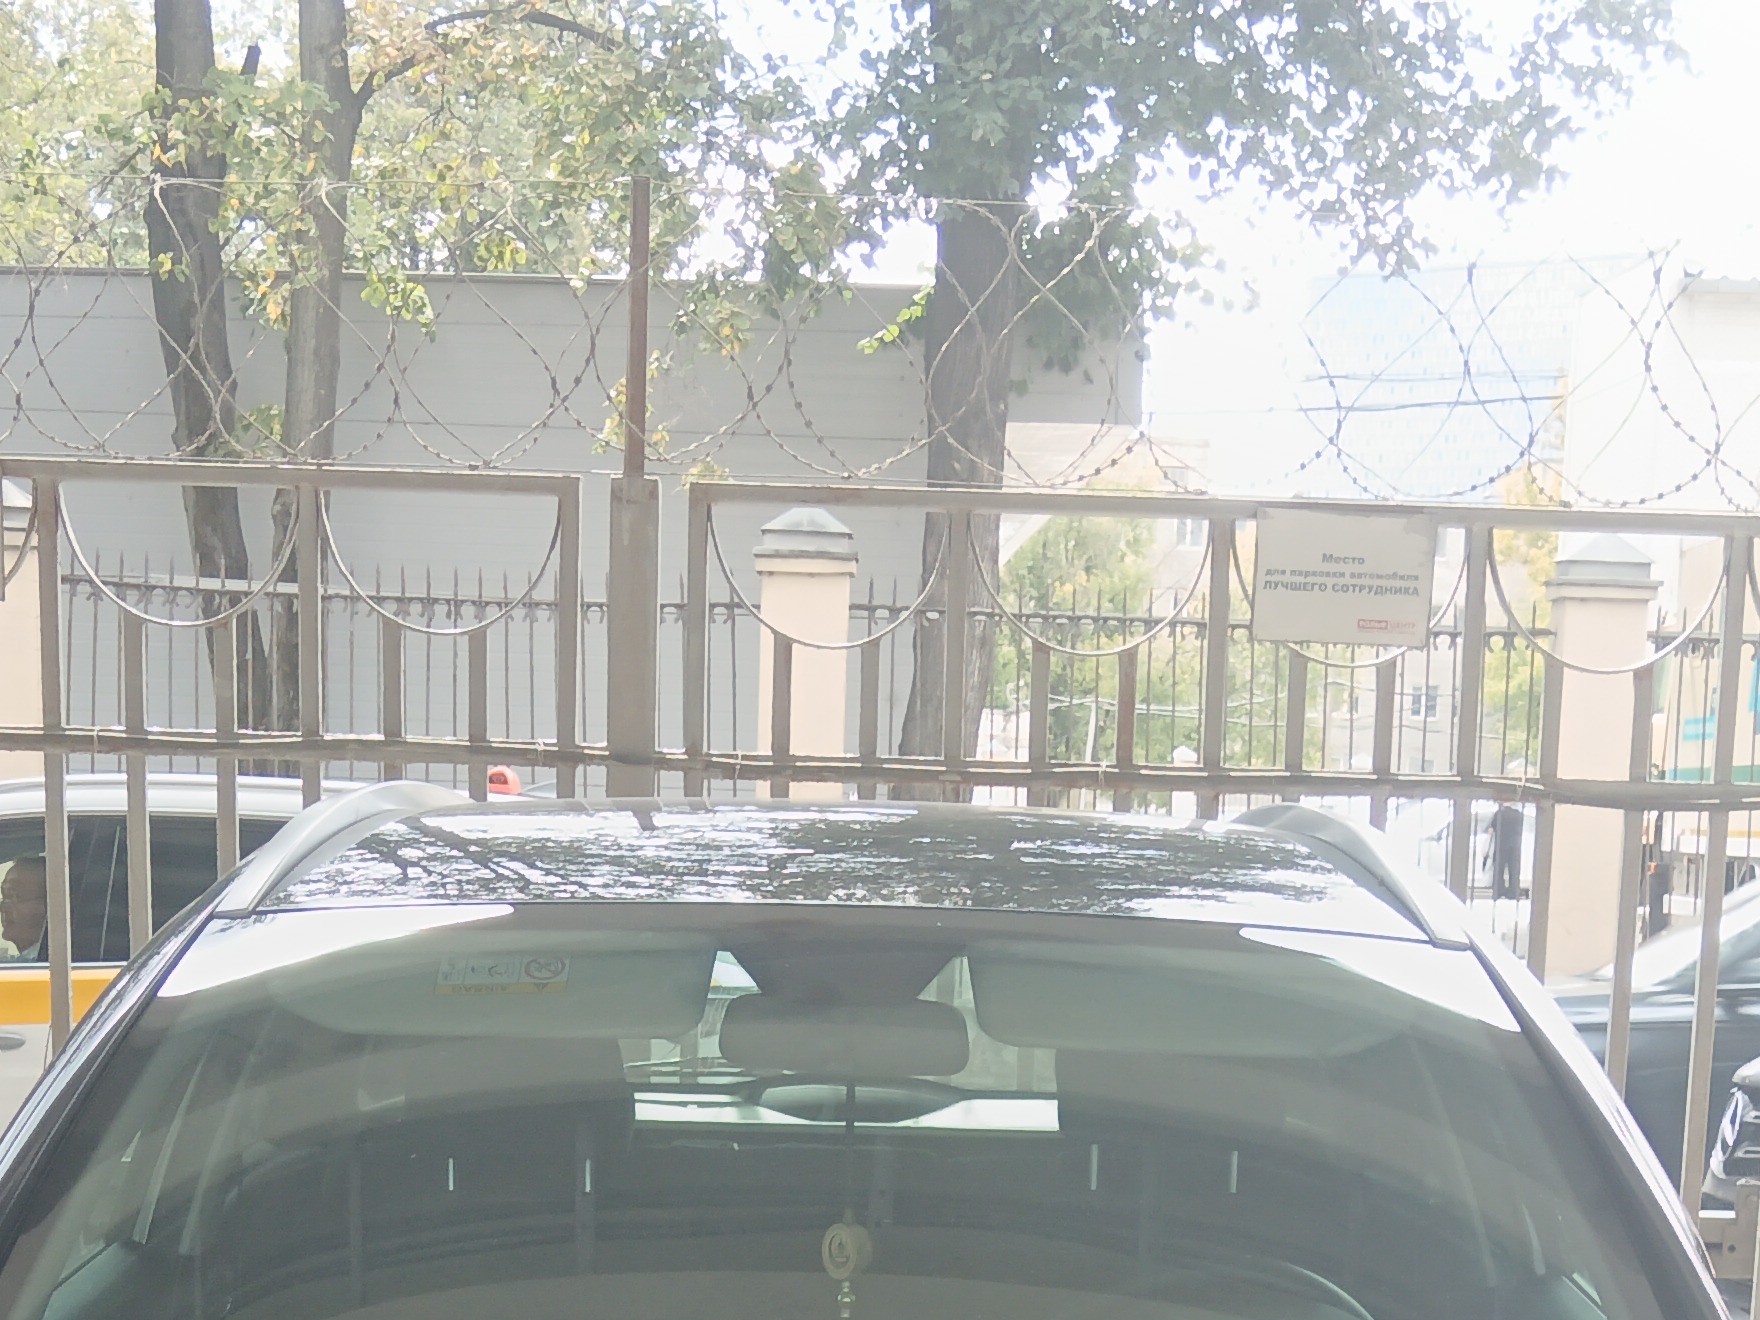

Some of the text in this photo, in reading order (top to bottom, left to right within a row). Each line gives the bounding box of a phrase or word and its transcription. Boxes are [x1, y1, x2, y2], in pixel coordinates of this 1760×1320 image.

[1321, 552, 1365, 565] Место
[1265, 567, 1420, 582] для парковки автомобиля
[1263, 580, 1420, 597] ЛУЧШЕГО СОТРУДНИКА
